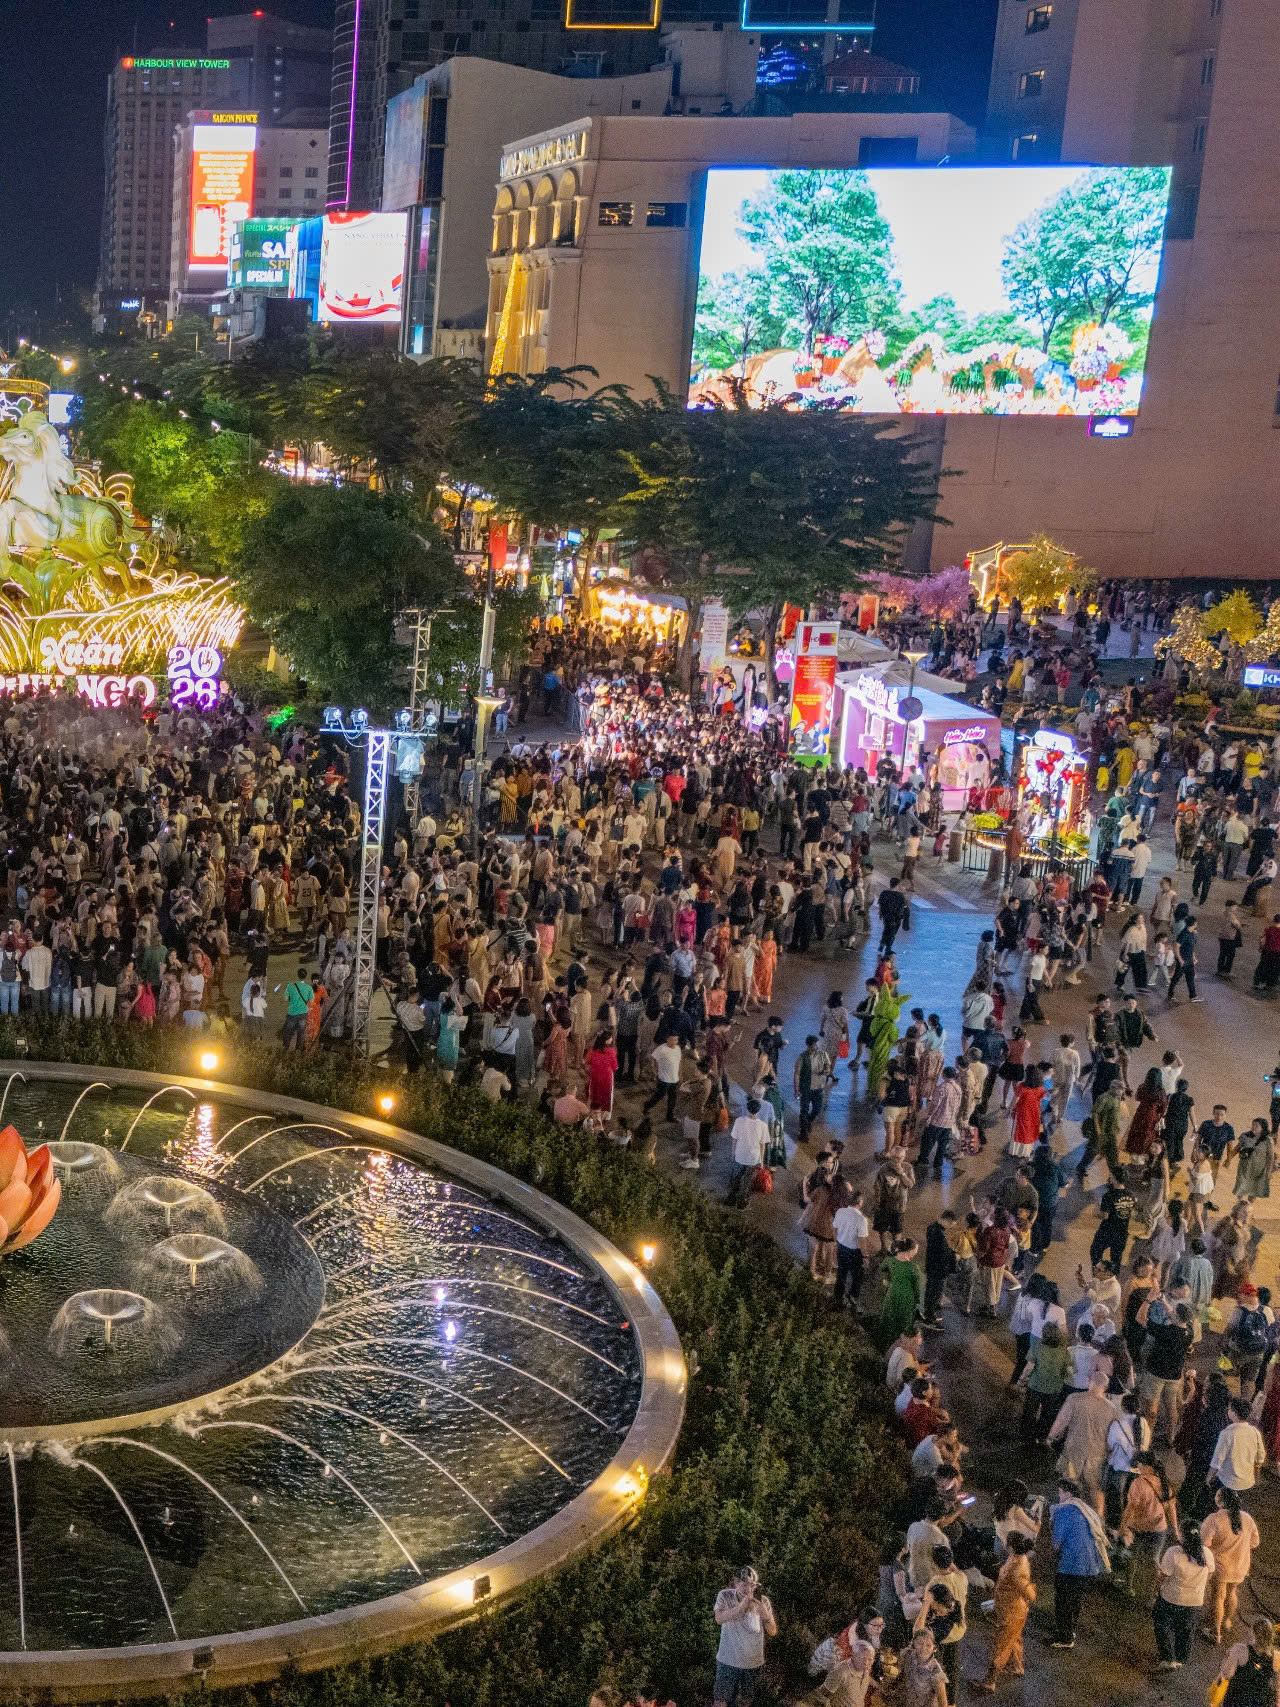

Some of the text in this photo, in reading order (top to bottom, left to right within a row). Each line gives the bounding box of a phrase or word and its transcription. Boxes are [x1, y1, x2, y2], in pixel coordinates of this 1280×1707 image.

[134, 60, 230, 69] HARBOUR VIEW TOWER
[212, 113, 258, 124] SAIGON PRINCE
[39, 630, 123, 676] Xuân
[168, 645, 221, 679] 20
[171, 676, 218, 710] 26
